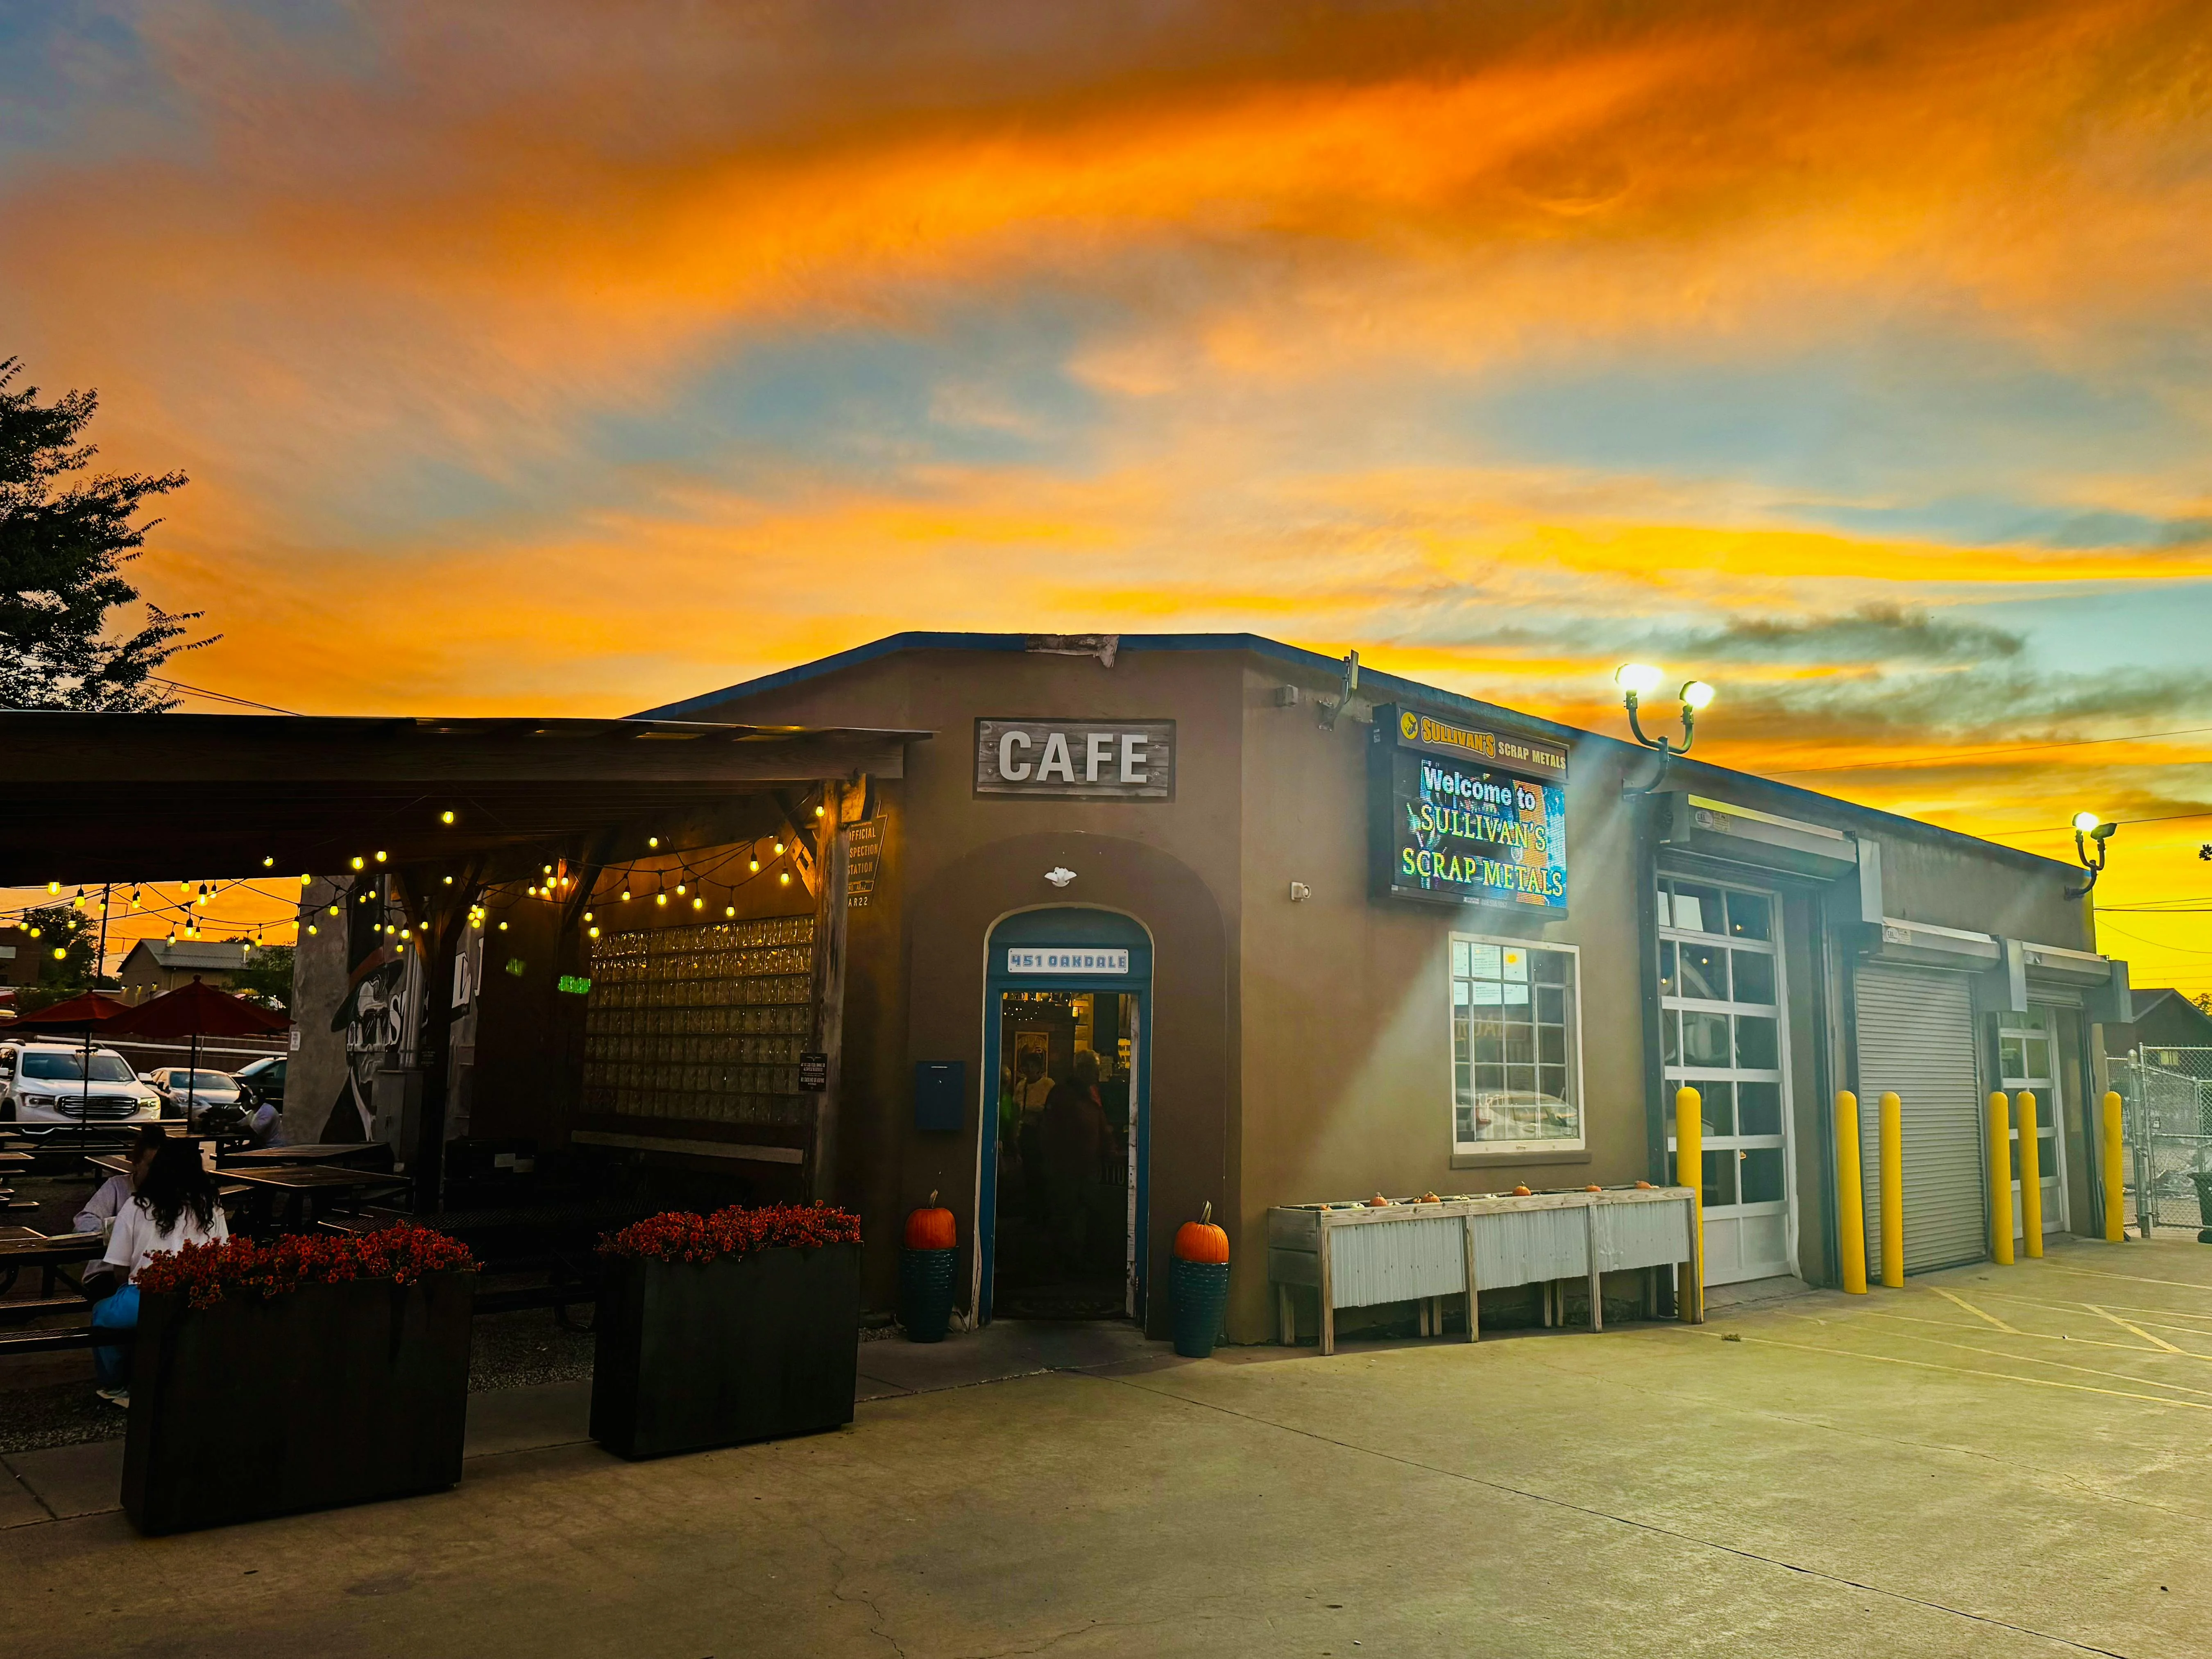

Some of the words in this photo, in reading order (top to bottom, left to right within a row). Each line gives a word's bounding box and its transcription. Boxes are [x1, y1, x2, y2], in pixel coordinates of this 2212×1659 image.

[999, 731, 1148, 783] CAFE
[1422, 717, 1494, 757] SULLIVAN'S
[1498, 741, 1529, 761] SCRAP
[1532, 750, 1566, 770] METALS
[1423, 766, 1512, 806] Welcome
[1517, 787, 1536, 810] to
[850, 843, 878, 858] SPECTION
[1421, 804, 1546, 852] SULLIVAN'S
[1403, 847, 1476, 884] SCRAP
[1482, 860, 1564, 897] METALS
[848, 896, 868, 907] AR22
[1011, 954, 1043, 967] 451
[1047, 954, 1126, 968] OAKDALE
